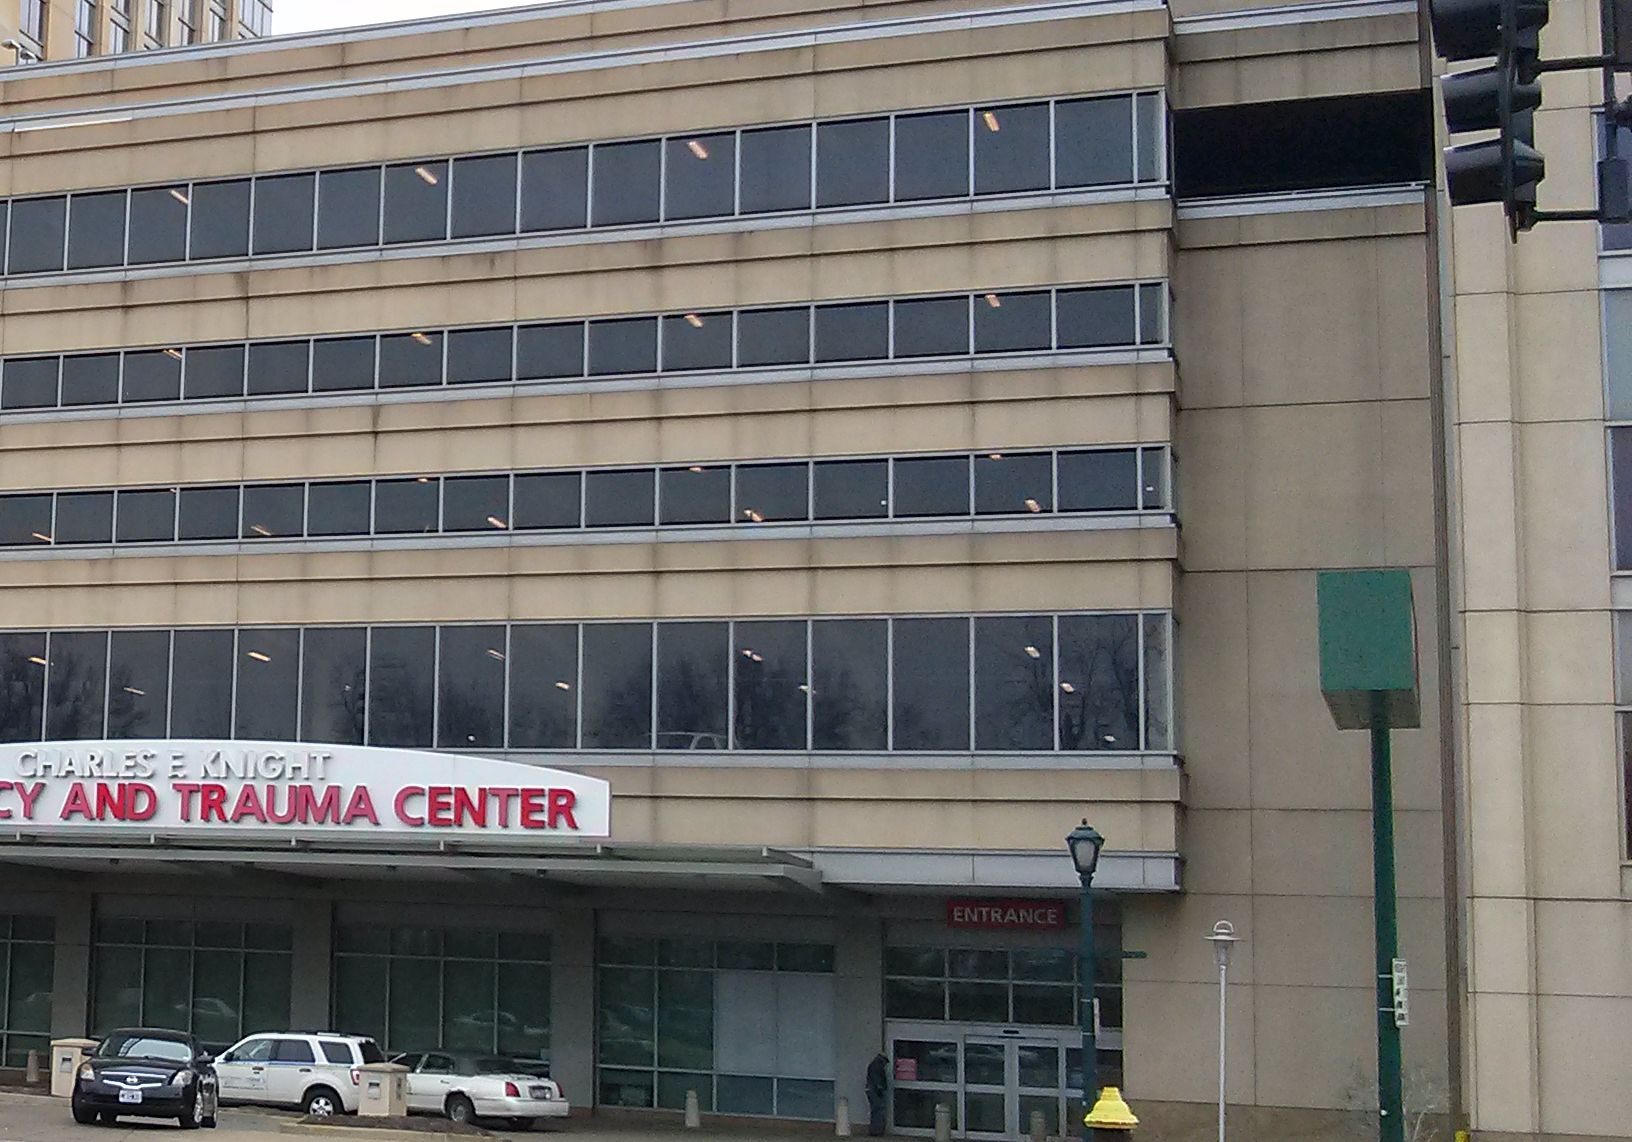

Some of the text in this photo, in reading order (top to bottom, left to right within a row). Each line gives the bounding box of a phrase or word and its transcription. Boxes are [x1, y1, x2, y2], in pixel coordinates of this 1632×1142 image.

[17, 749, 156, 779] CHARLES
[200, 750, 332, 780] KNIGHT
[59, 781, 158, 822] AND
[172, 782, 381, 826] TRAUMA
[392, 785, 579, 830] CENTER
[953, 906, 1058, 925] ENTRANCE
